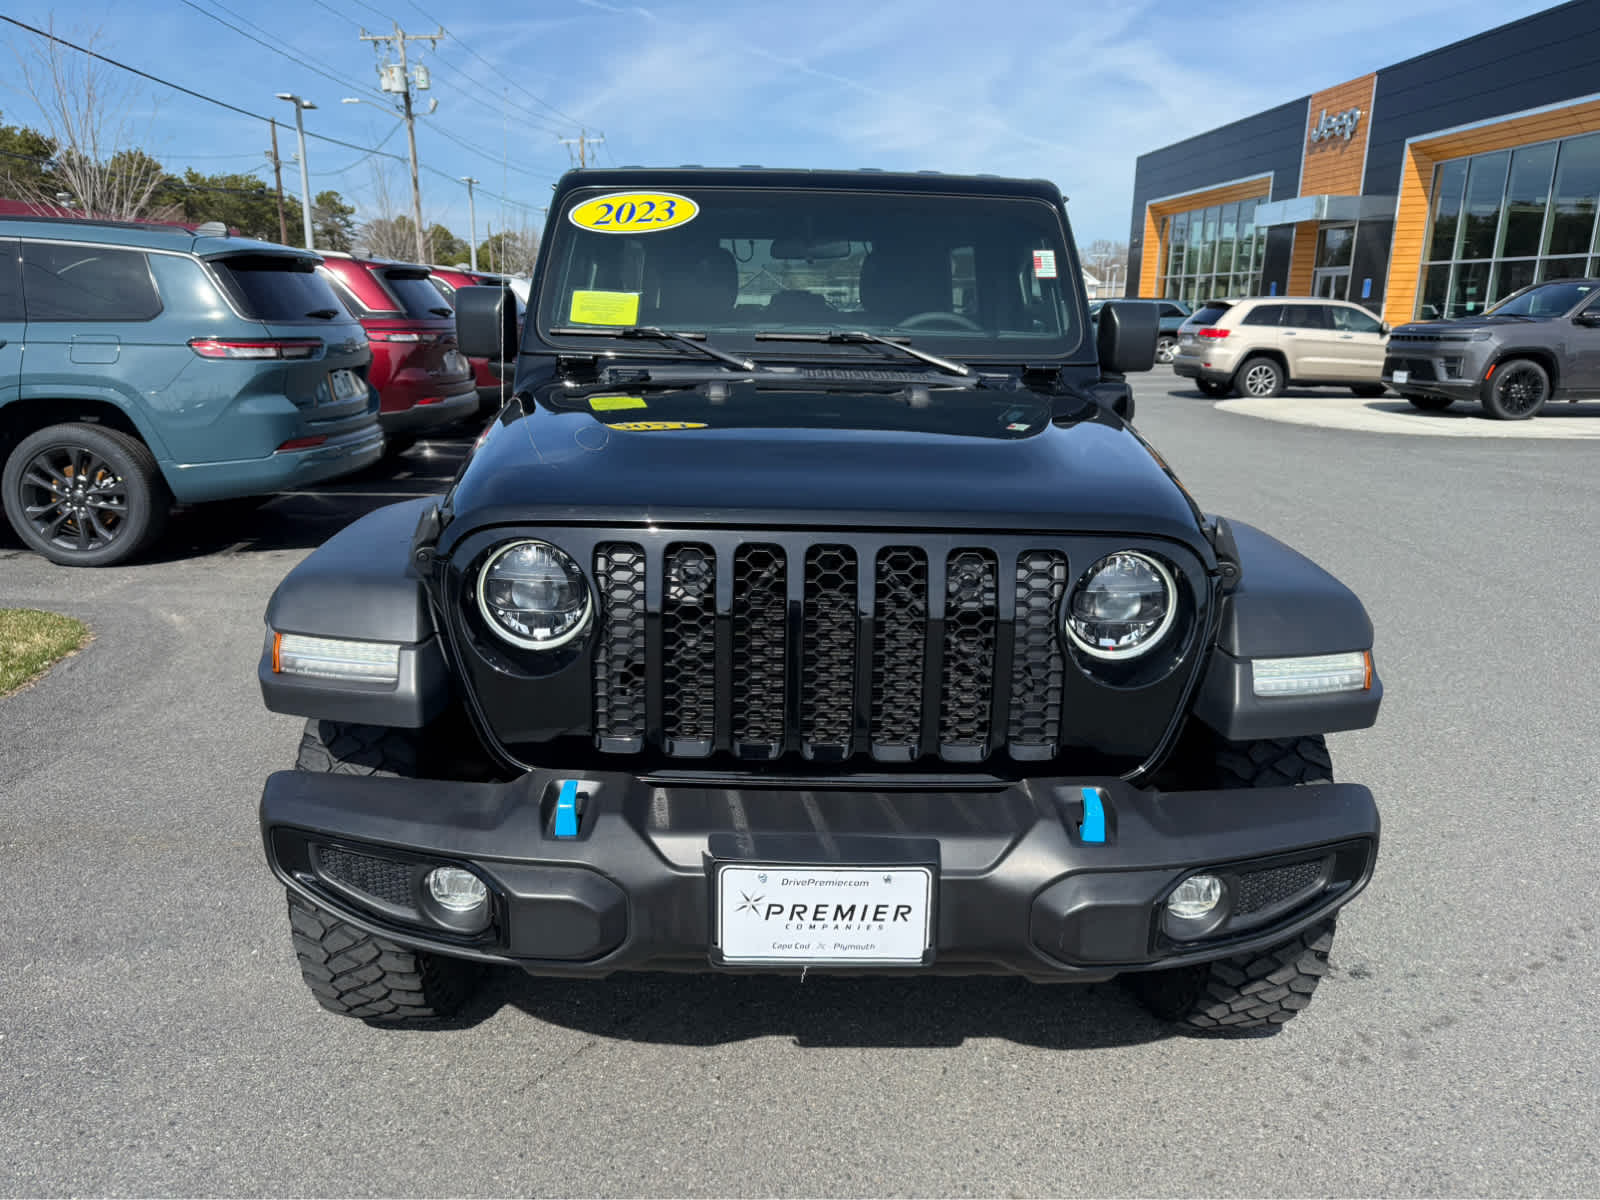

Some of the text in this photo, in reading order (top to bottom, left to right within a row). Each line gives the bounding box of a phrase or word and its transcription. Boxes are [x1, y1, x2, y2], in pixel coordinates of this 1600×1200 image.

[1311, 107, 1361, 143] Jeep
[593, 200, 677, 225] 2023
[781, 878, 870, 887] DrivePremier.com
[765, 903, 912, 922] PREMIER
[772, 942, 876, 951] Cape Cod Plymouth
